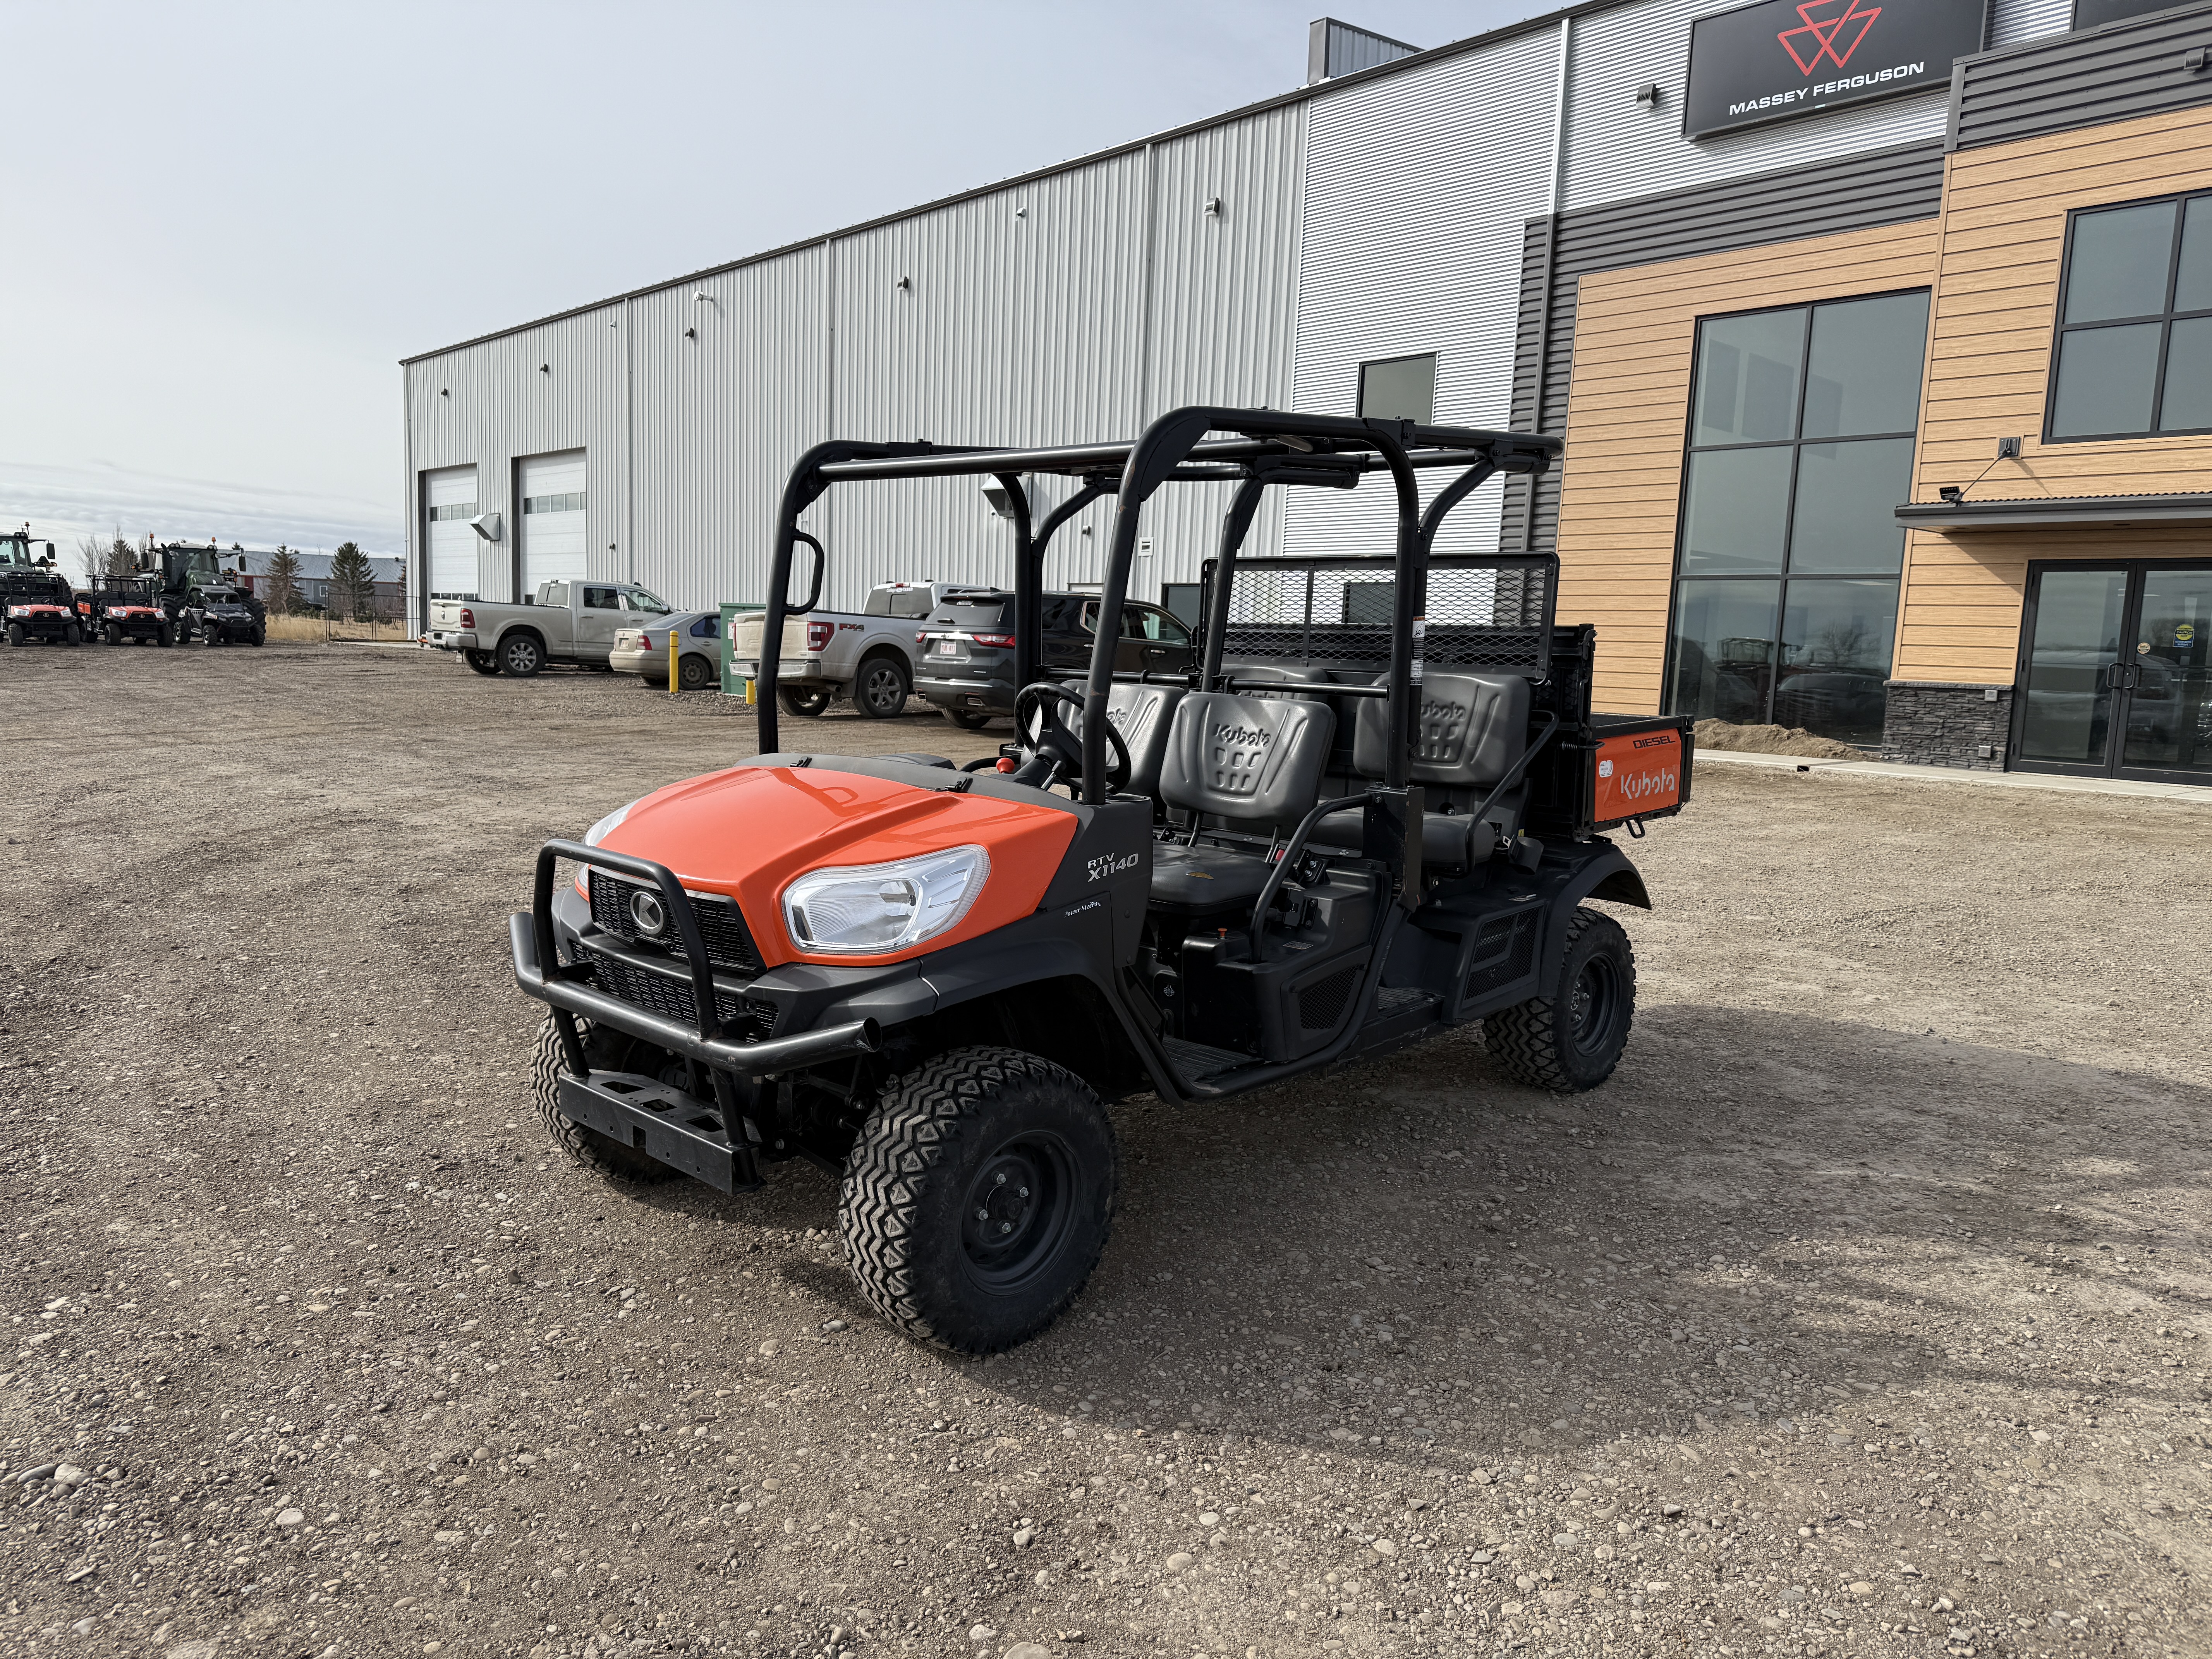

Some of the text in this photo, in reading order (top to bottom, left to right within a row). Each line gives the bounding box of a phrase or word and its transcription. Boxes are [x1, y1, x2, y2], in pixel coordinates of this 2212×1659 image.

[1728, 61, 1924, 116] MASSEY FERGUSON
[1420, 700, 1466, 721] ubota
[1213, 723, 1271, 748] Kubota
[1632, 735, 1676, 749] DIESEL
[1621, 768, 1675, 800] Kubota
[1087, 852, 1115, 869] RTV
[1087, 853, 1139, 883] X1140
[1064, 908, 1081, 918] Power
